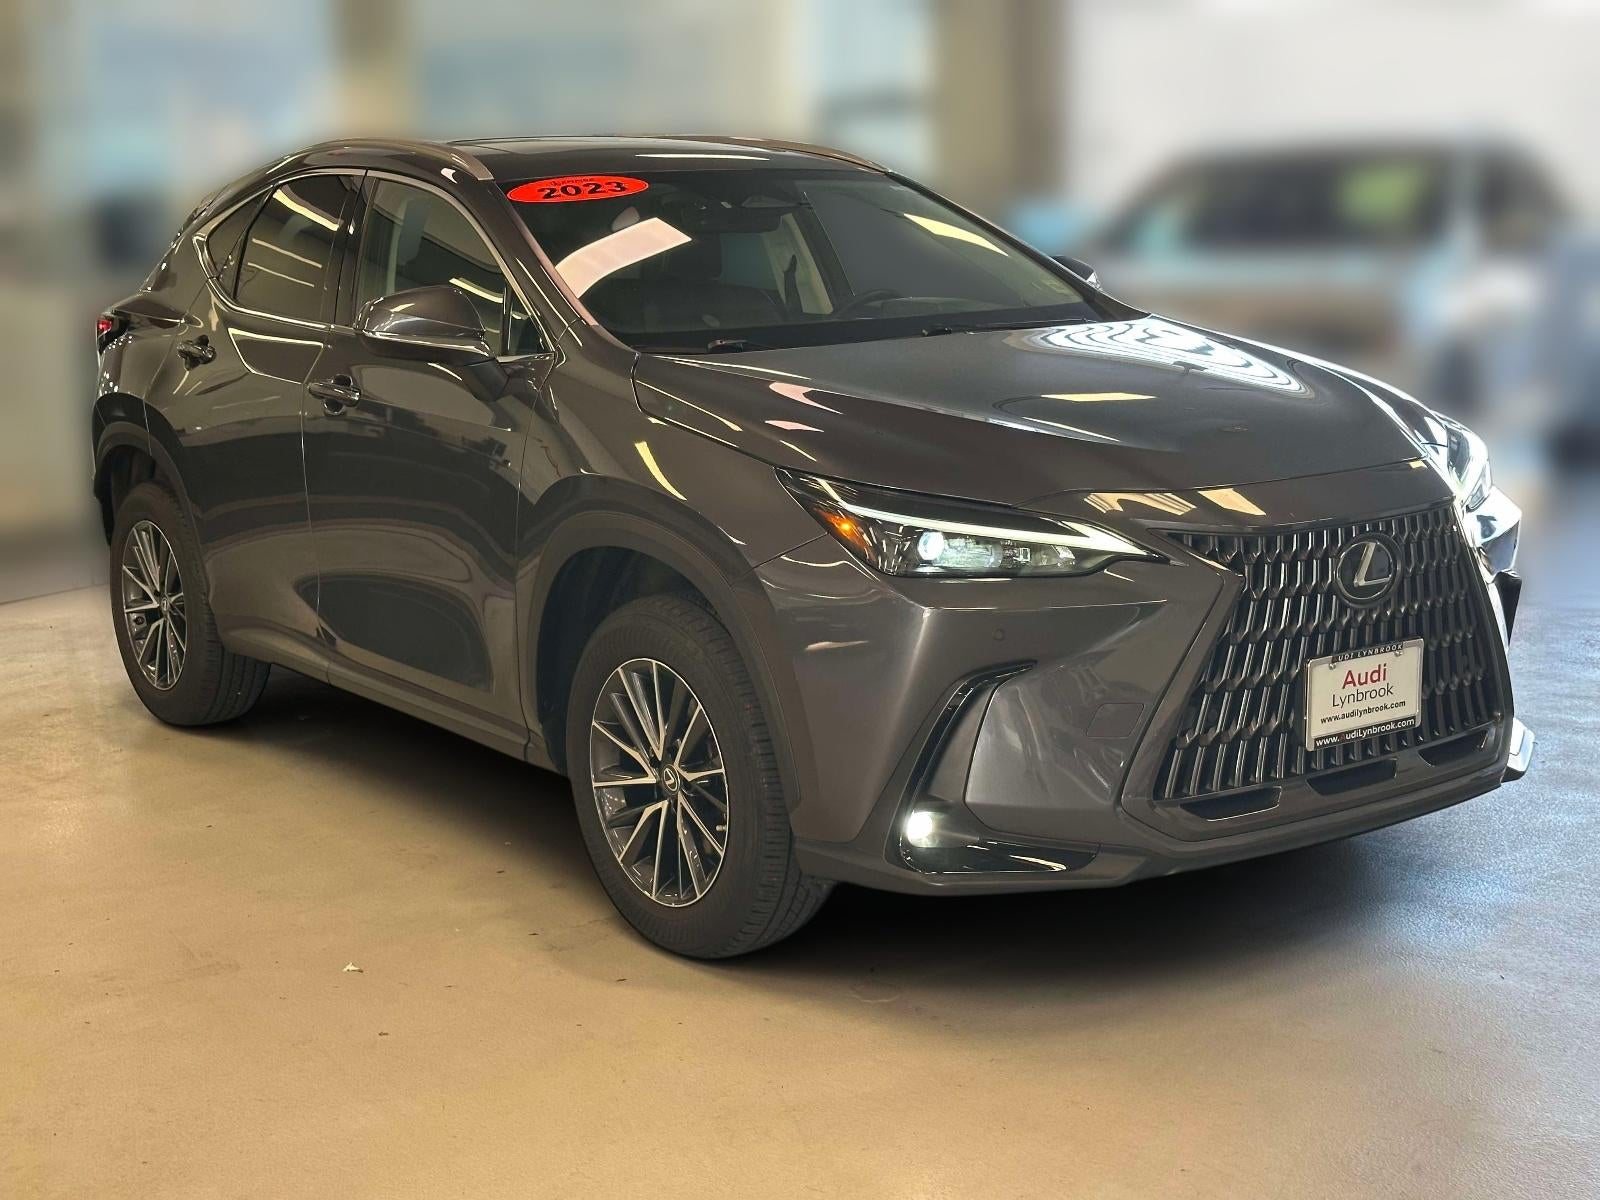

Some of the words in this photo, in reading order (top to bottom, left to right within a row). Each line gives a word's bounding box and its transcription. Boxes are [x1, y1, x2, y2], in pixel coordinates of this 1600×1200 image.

[537, 181, 627, 199] 2023
[1357, 644, 1403, 657] LYNBROOK
[1342, 663, 1387, 689] Audi
[1332, 683, 1394, 708] Lynbrook
[1320, 700, 1406, 724] www.audilynbrook.com
